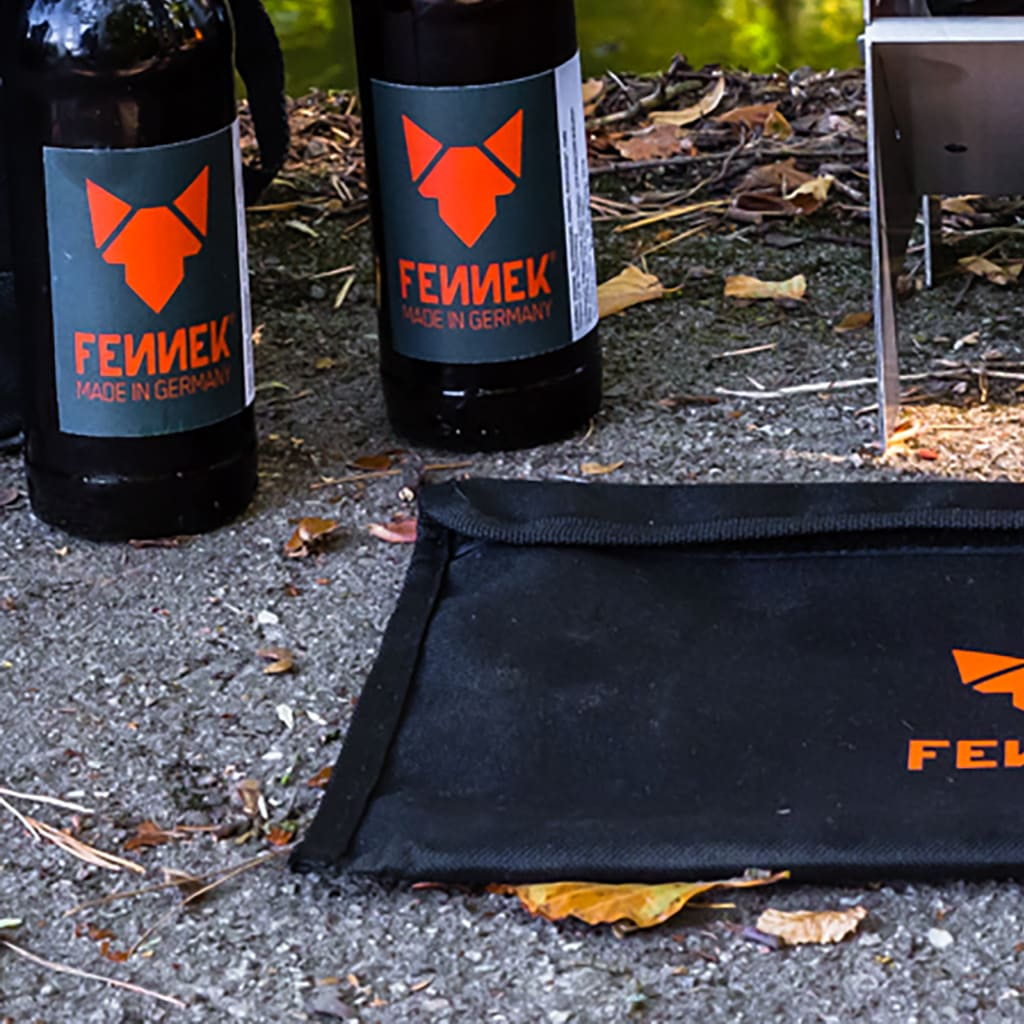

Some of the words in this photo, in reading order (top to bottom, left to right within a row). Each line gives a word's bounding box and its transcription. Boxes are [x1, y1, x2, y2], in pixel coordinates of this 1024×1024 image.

[402, 305, 444, 329] MADE
[447, 311, 465, 330] IN
[468, 300, 553, 332] GERMANY
[76, 379, 127, 403] MADE
[131, 378, 152, 401] IN
[153, 367, 231, 399] GERMANY
